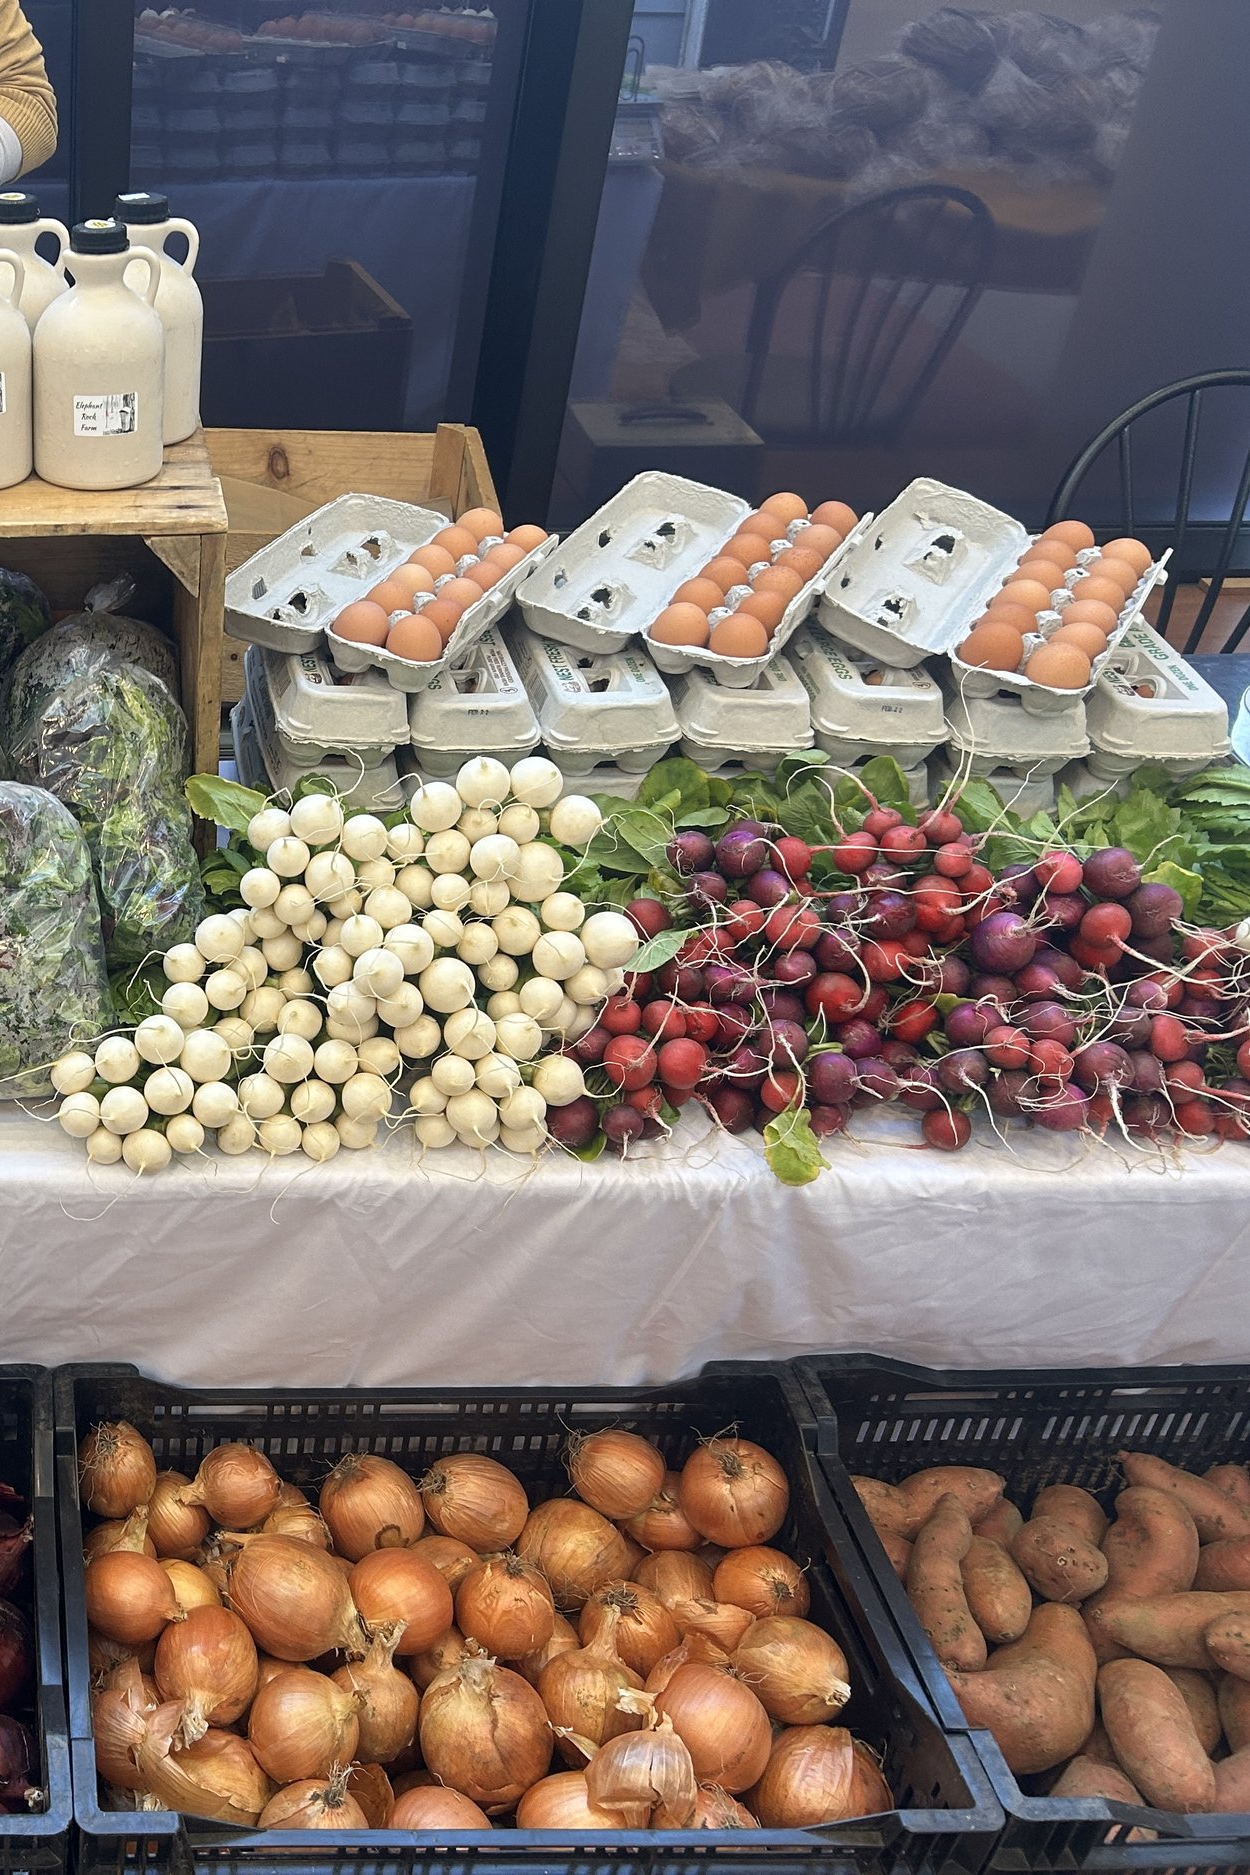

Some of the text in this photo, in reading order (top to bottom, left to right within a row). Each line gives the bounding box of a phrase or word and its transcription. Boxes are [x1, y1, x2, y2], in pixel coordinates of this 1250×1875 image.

[75, 401, 103, 411] Elephant
[81, 413, 96, 421] Rock
[1133, 633, 1169, 661] GRADE
[551, 664, 574, 681] NEST
[827, 656, 853, 680] EGGS
